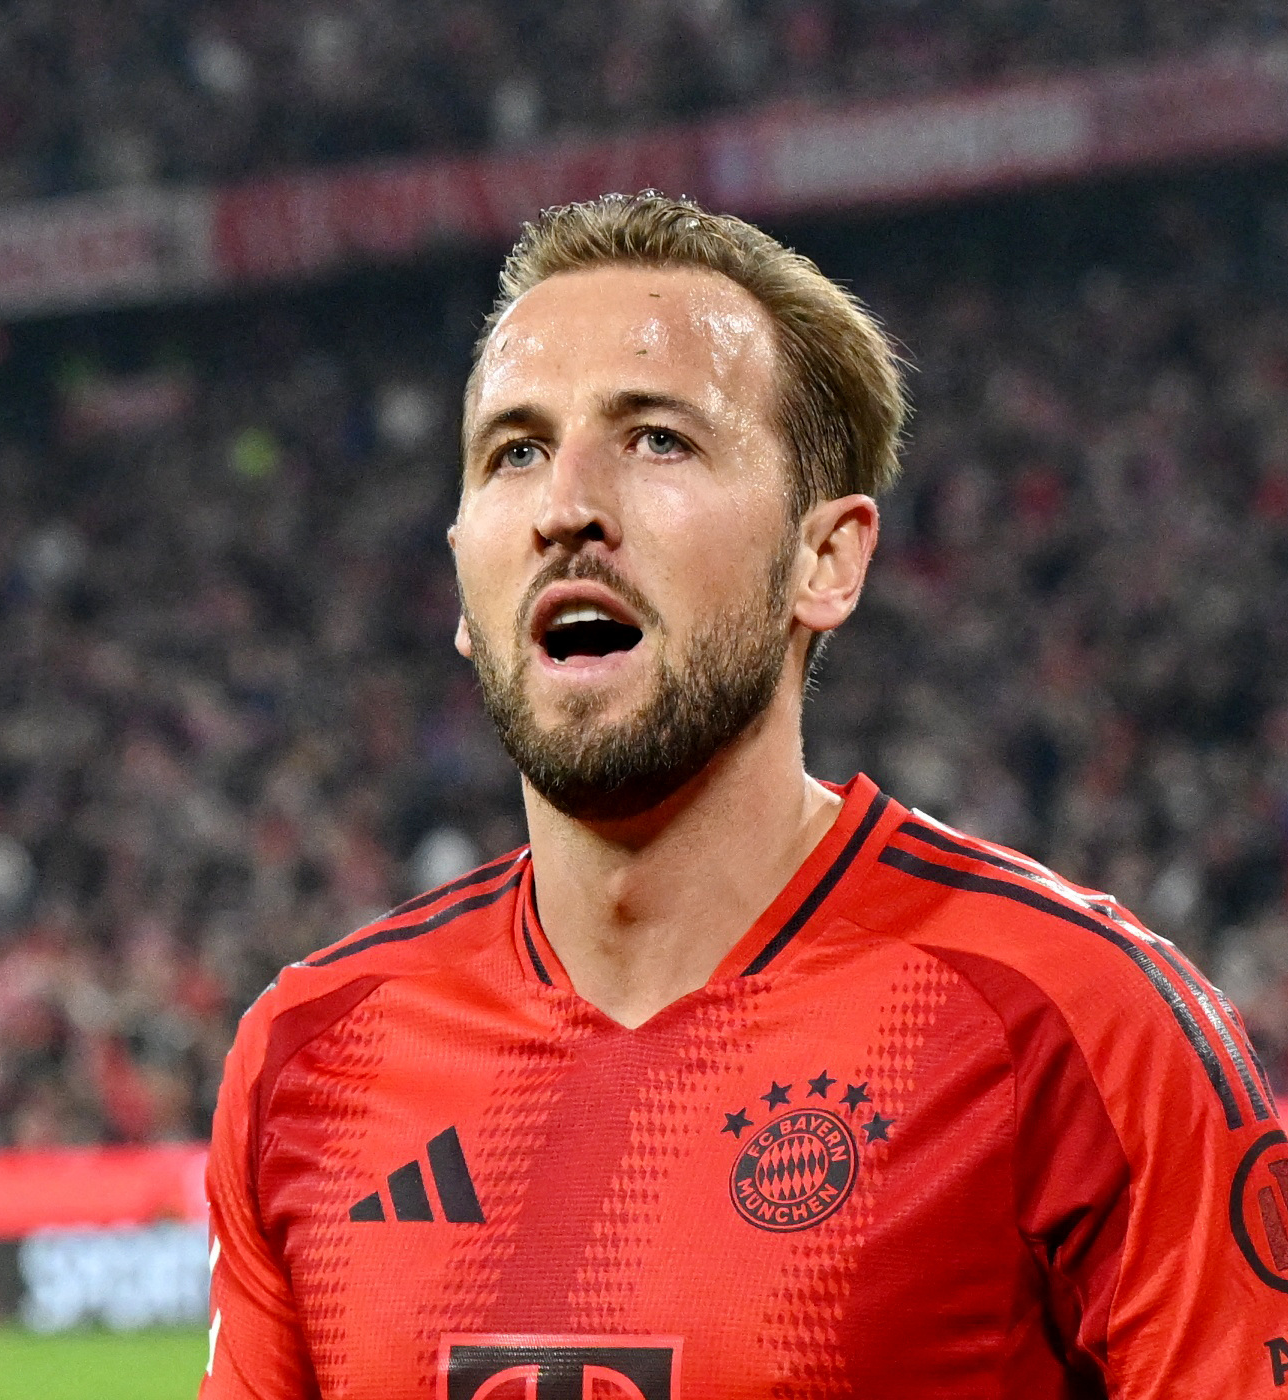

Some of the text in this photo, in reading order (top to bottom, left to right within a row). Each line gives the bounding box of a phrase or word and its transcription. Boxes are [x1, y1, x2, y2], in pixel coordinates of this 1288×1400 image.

[747, 1116, 847, 1162] FC BAYERN
[737, 1177, 838, 1223] MÜNCHEN
